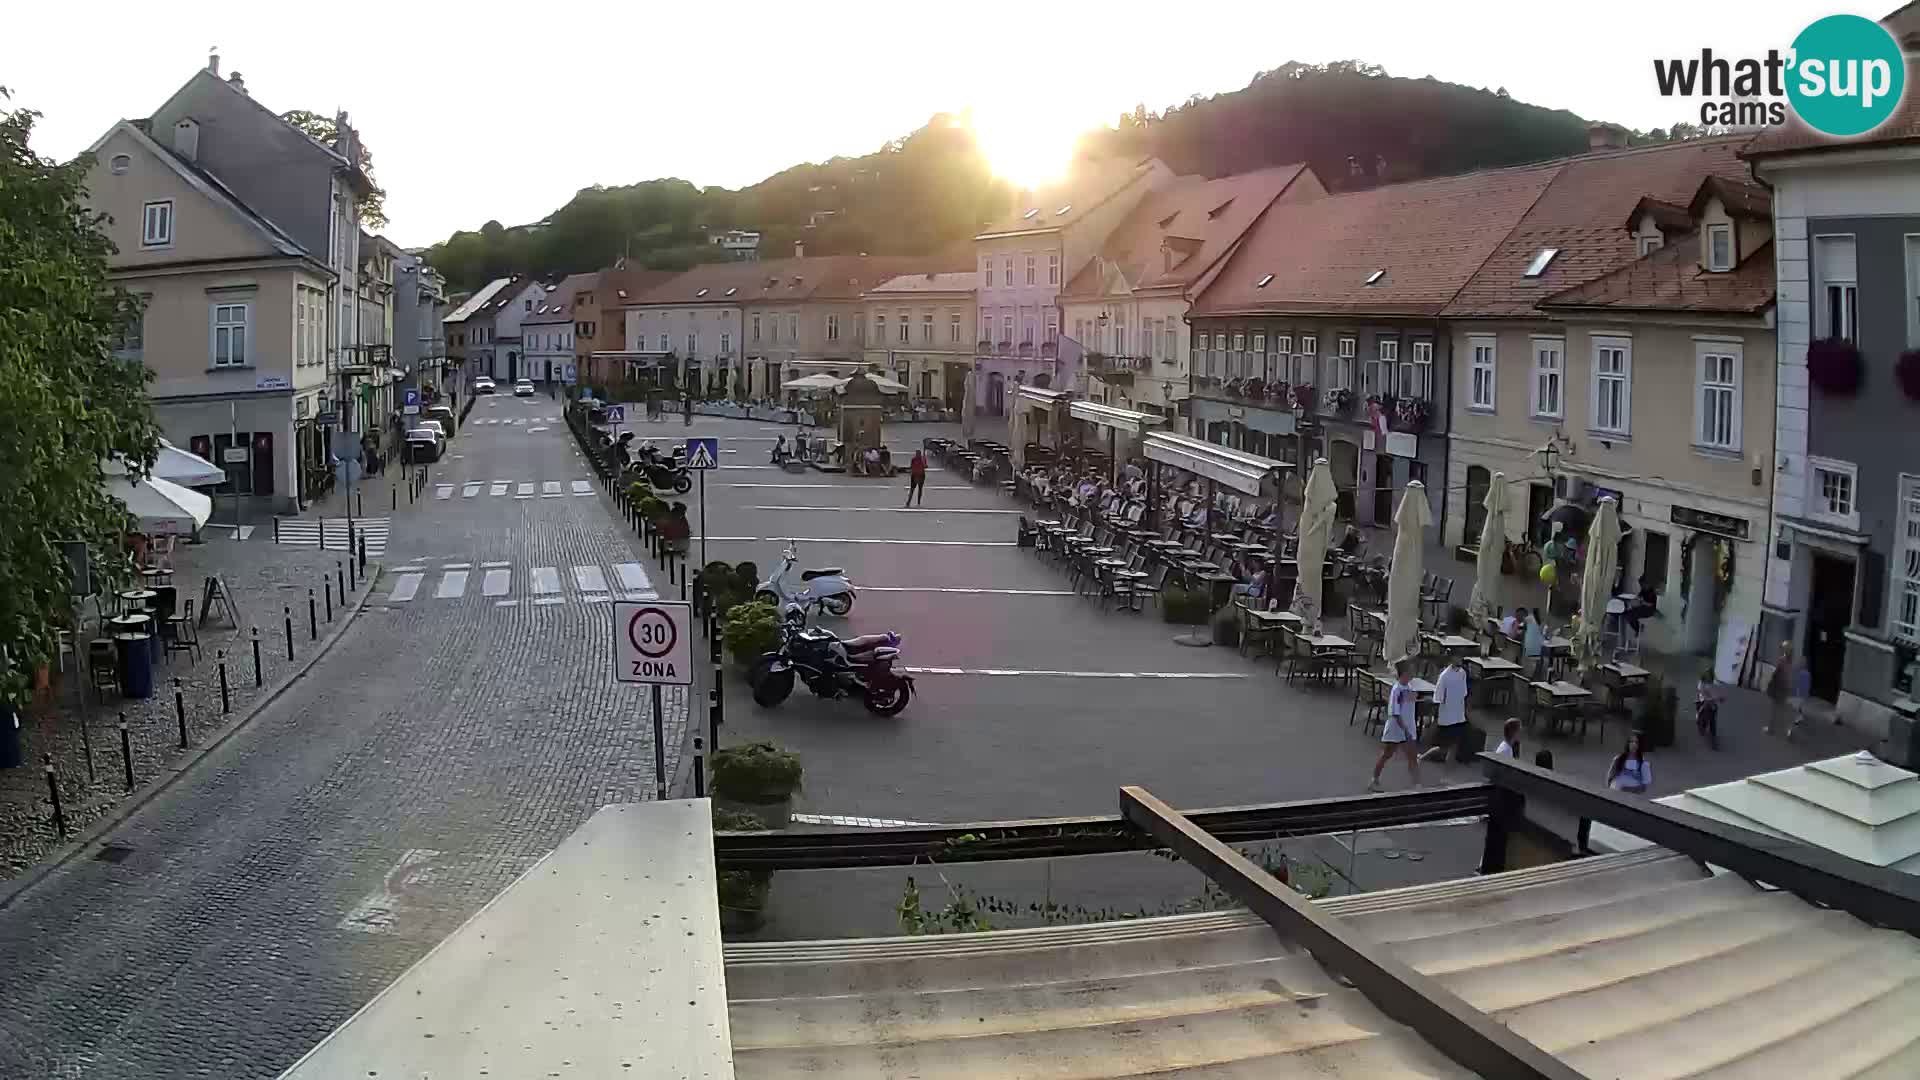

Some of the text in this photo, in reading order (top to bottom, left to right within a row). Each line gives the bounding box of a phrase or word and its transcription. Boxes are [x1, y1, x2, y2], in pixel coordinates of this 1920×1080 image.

[407, 392, 416, 404] P
[641, 623, 665, 645] 30
[631, 660, 677, 678] ZONA
